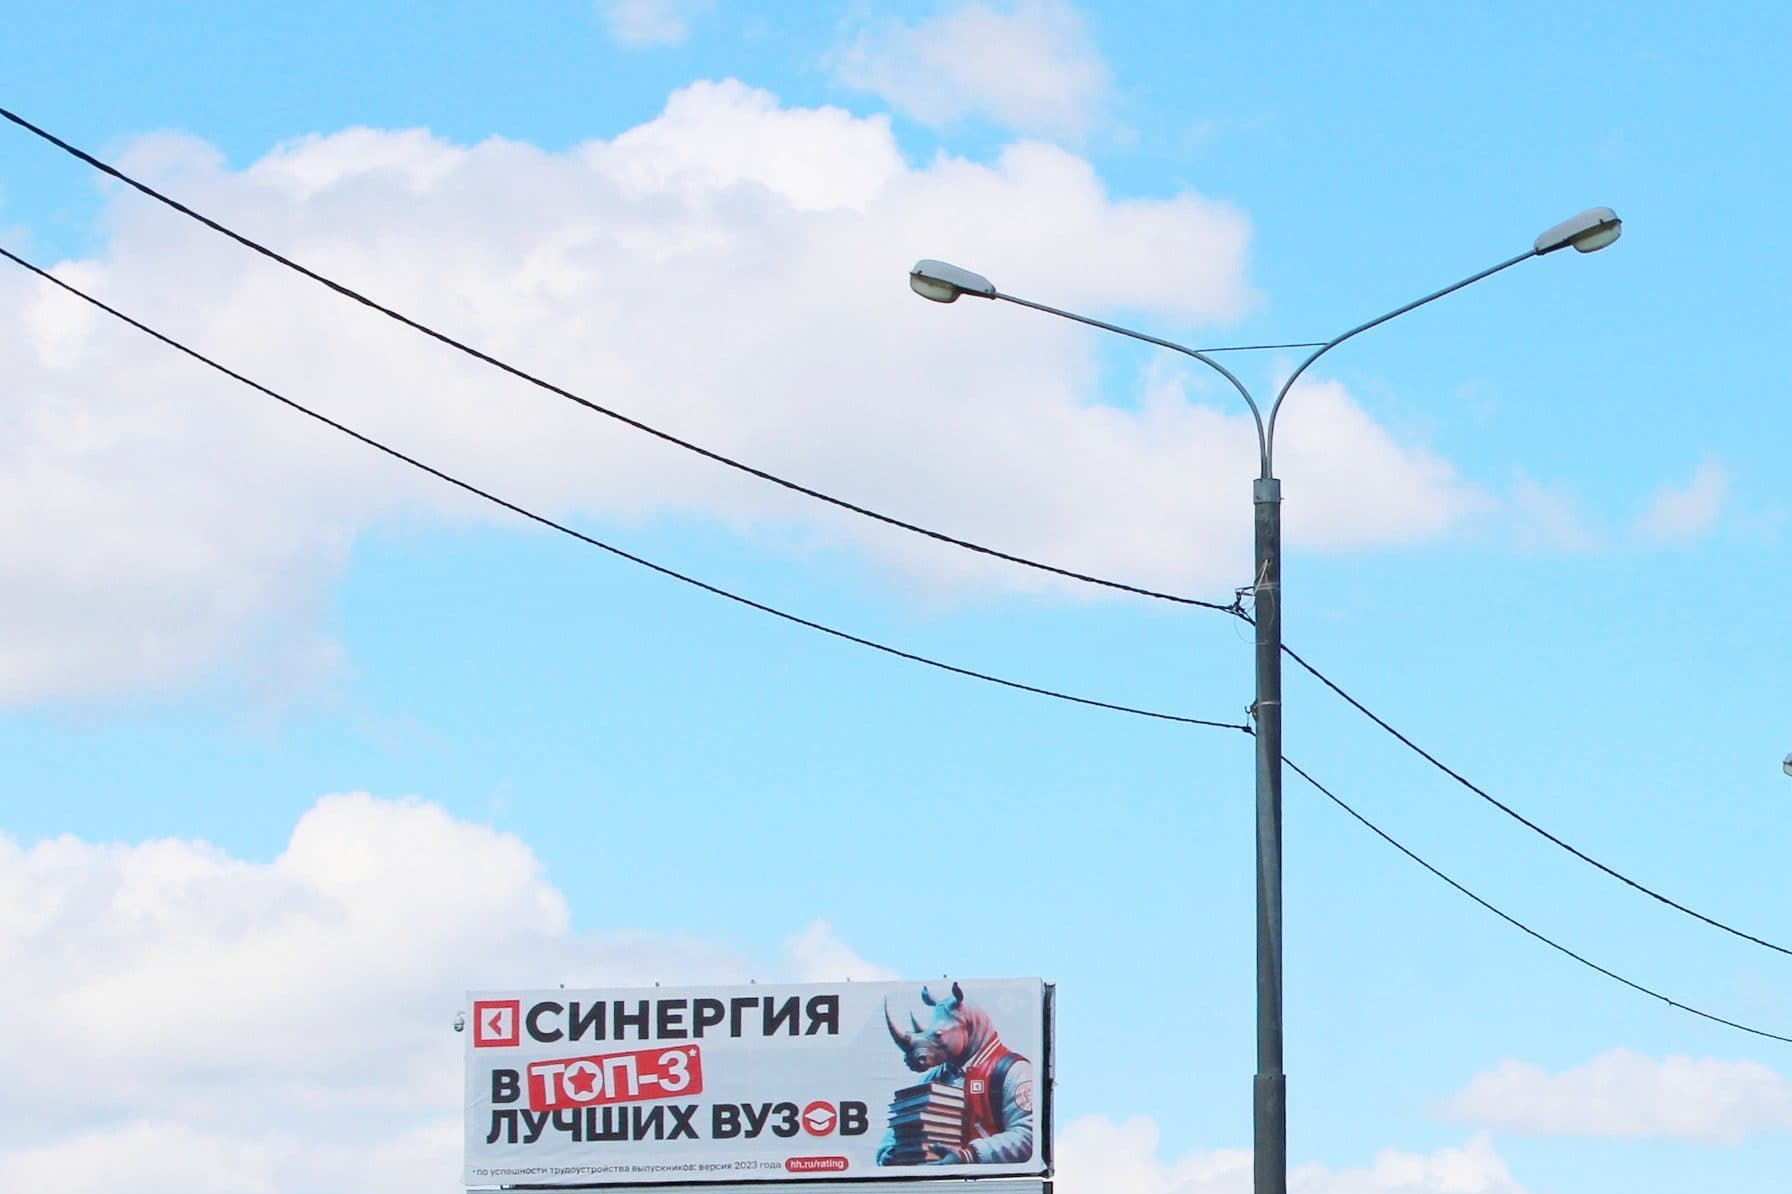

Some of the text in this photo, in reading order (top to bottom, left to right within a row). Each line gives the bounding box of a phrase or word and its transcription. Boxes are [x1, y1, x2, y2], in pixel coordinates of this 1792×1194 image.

[525, 995, 839, 1042] СИНЕРГИЯ
[491, 1069, 521, 1103] В
[486, 1101, 869, 1144] ЛУЧШИХ ВУЗОВ
[490, 1167, 549, 1177] успешности
[550, 1165, 630, 1176] трудоустройства
[632, 1163, 697, 1173] выпускников:
[698, 1162, 732, 1172] версия
[734, 1161, 758, 1170] 2023
[760, 1161, 782, 1170] года
[789, 1159, 844, 1171] hh.ru/rating
